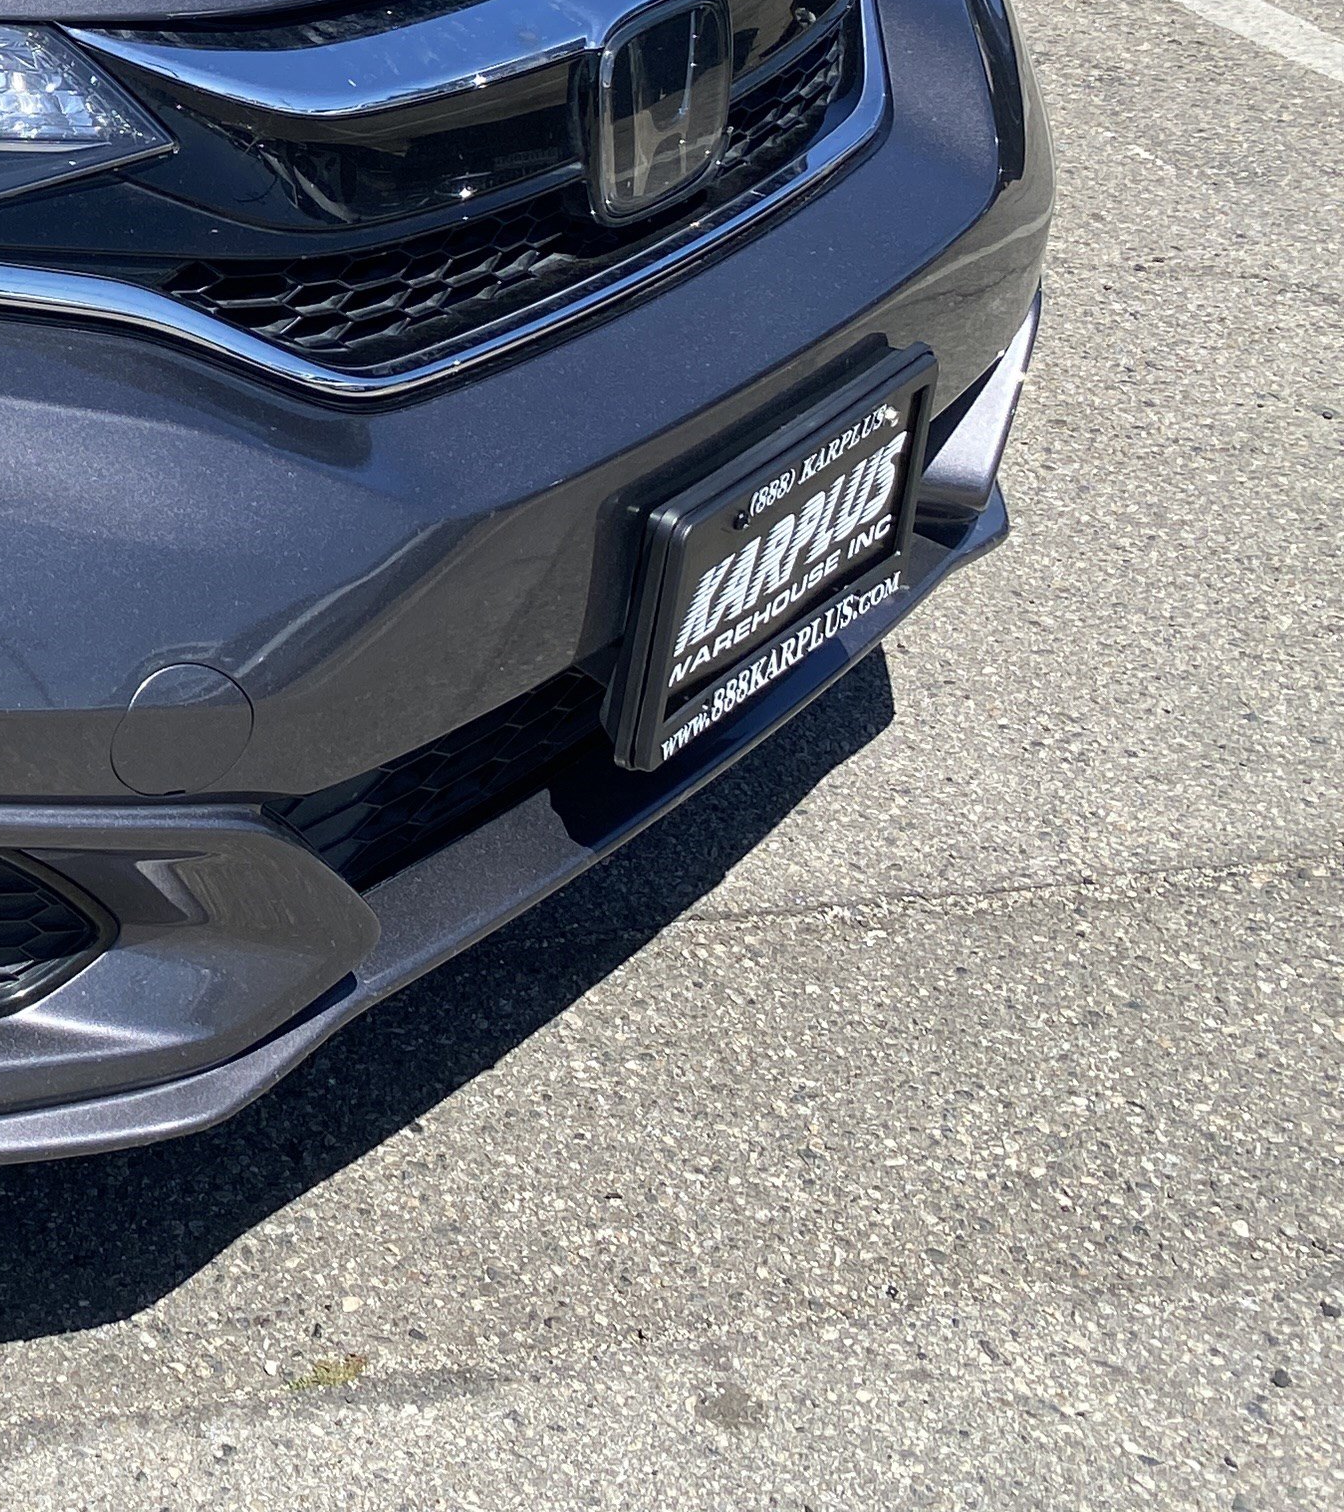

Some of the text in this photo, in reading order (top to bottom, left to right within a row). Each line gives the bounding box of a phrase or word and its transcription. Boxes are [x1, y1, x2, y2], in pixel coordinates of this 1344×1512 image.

[750, 403, 888, 517] (888) KARPLUS
[673, 431, 908, 658] KARPLUS
[847, 514, 892, 558] INC
